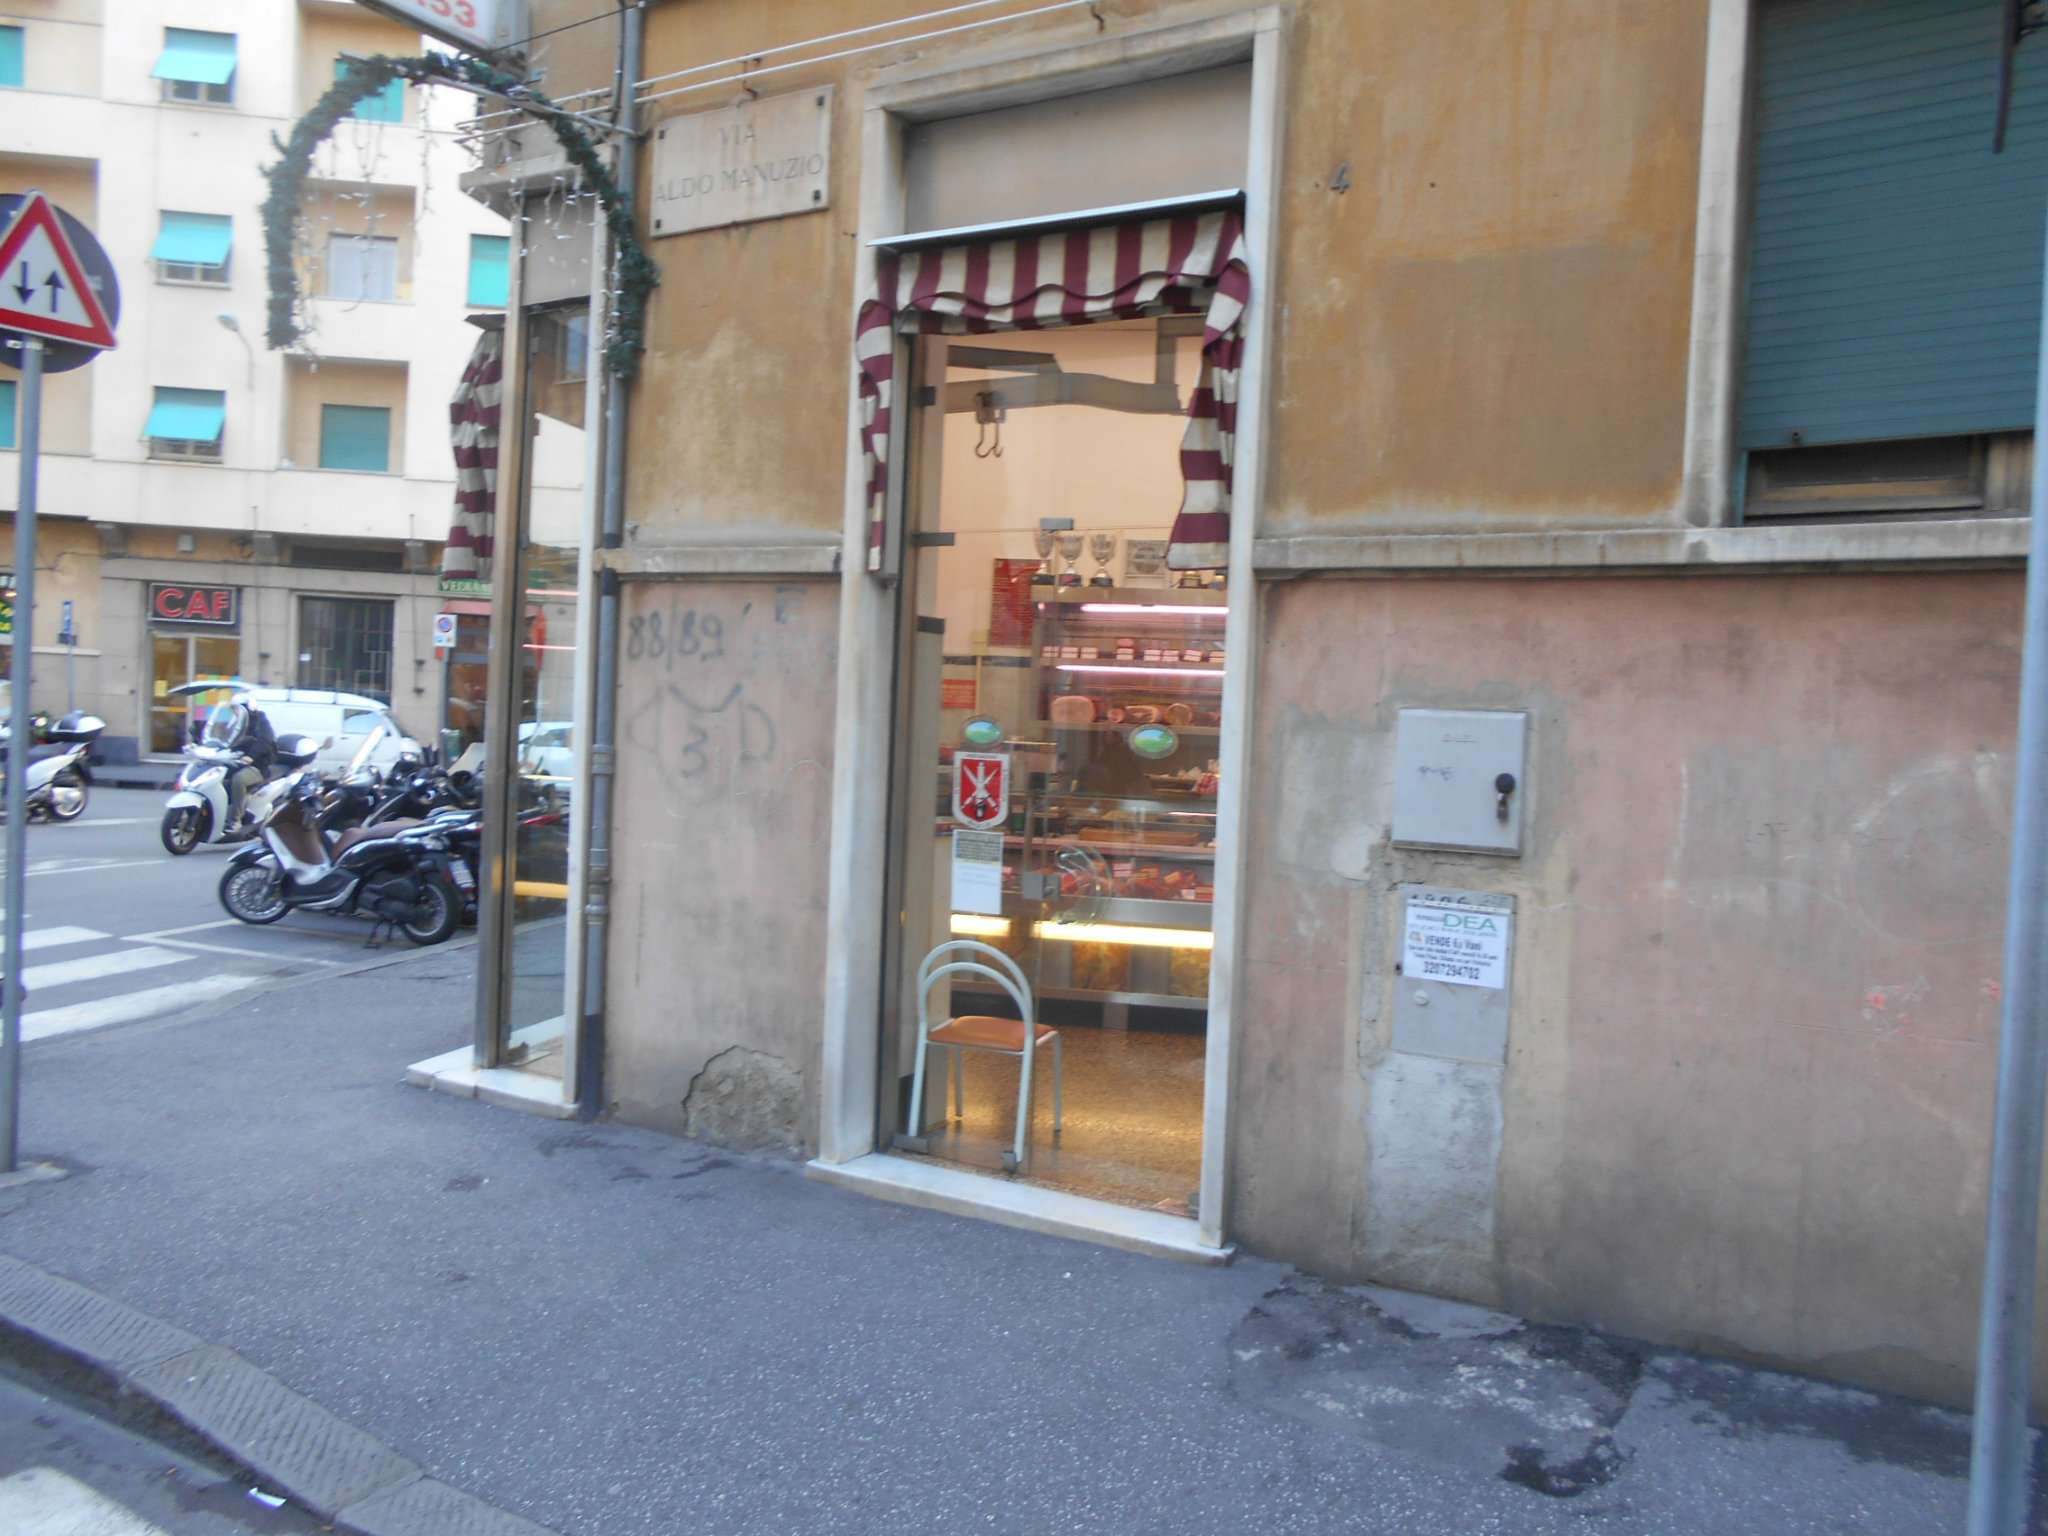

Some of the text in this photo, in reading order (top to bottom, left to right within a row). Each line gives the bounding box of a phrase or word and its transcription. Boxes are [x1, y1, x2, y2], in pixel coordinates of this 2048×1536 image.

[415, 0, 478, 29] 53
[719, 123, 758, 146] VIA
[655, 152, 825, 202] ALDO MANUZIO
[155, 587, 230, 620] CAF
[1443, 912, 1498, 932] DEA
